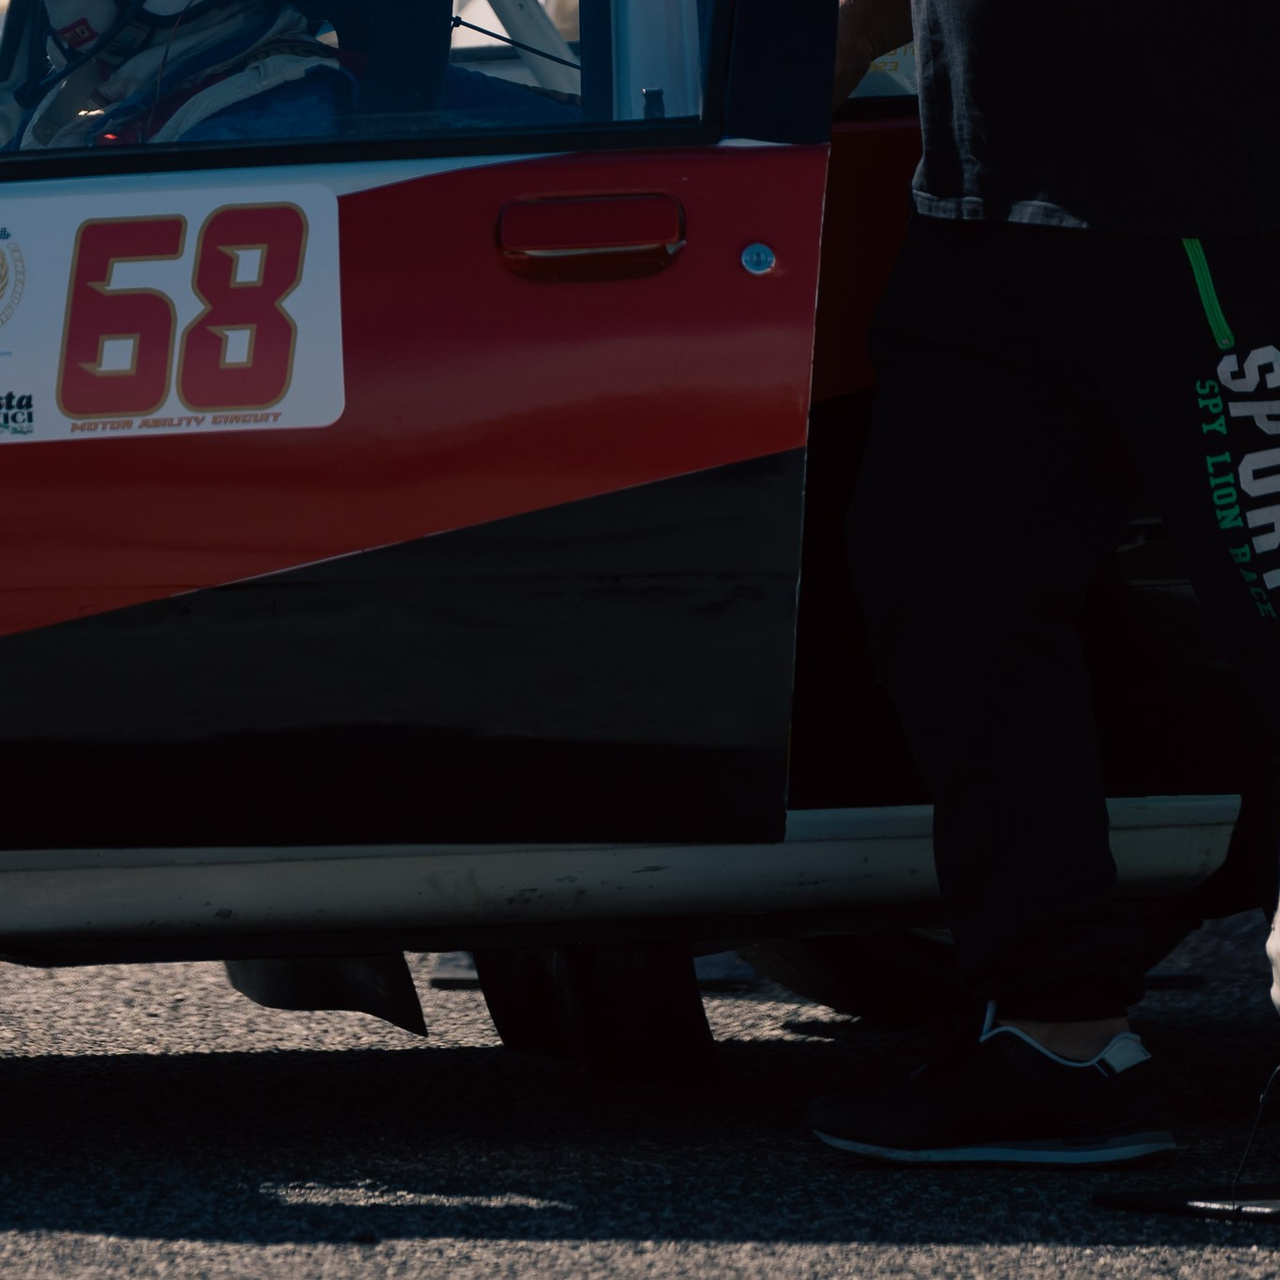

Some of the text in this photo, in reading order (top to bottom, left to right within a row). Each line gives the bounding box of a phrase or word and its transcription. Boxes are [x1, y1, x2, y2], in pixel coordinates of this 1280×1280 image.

[55, 201, 309, 420] 68
[70, 412, 282, 432] MOTOR ABILITY CIRCUIT
[1195, 378, 1229, 436] SPY
[1205, 450, 1245, 531] LION
